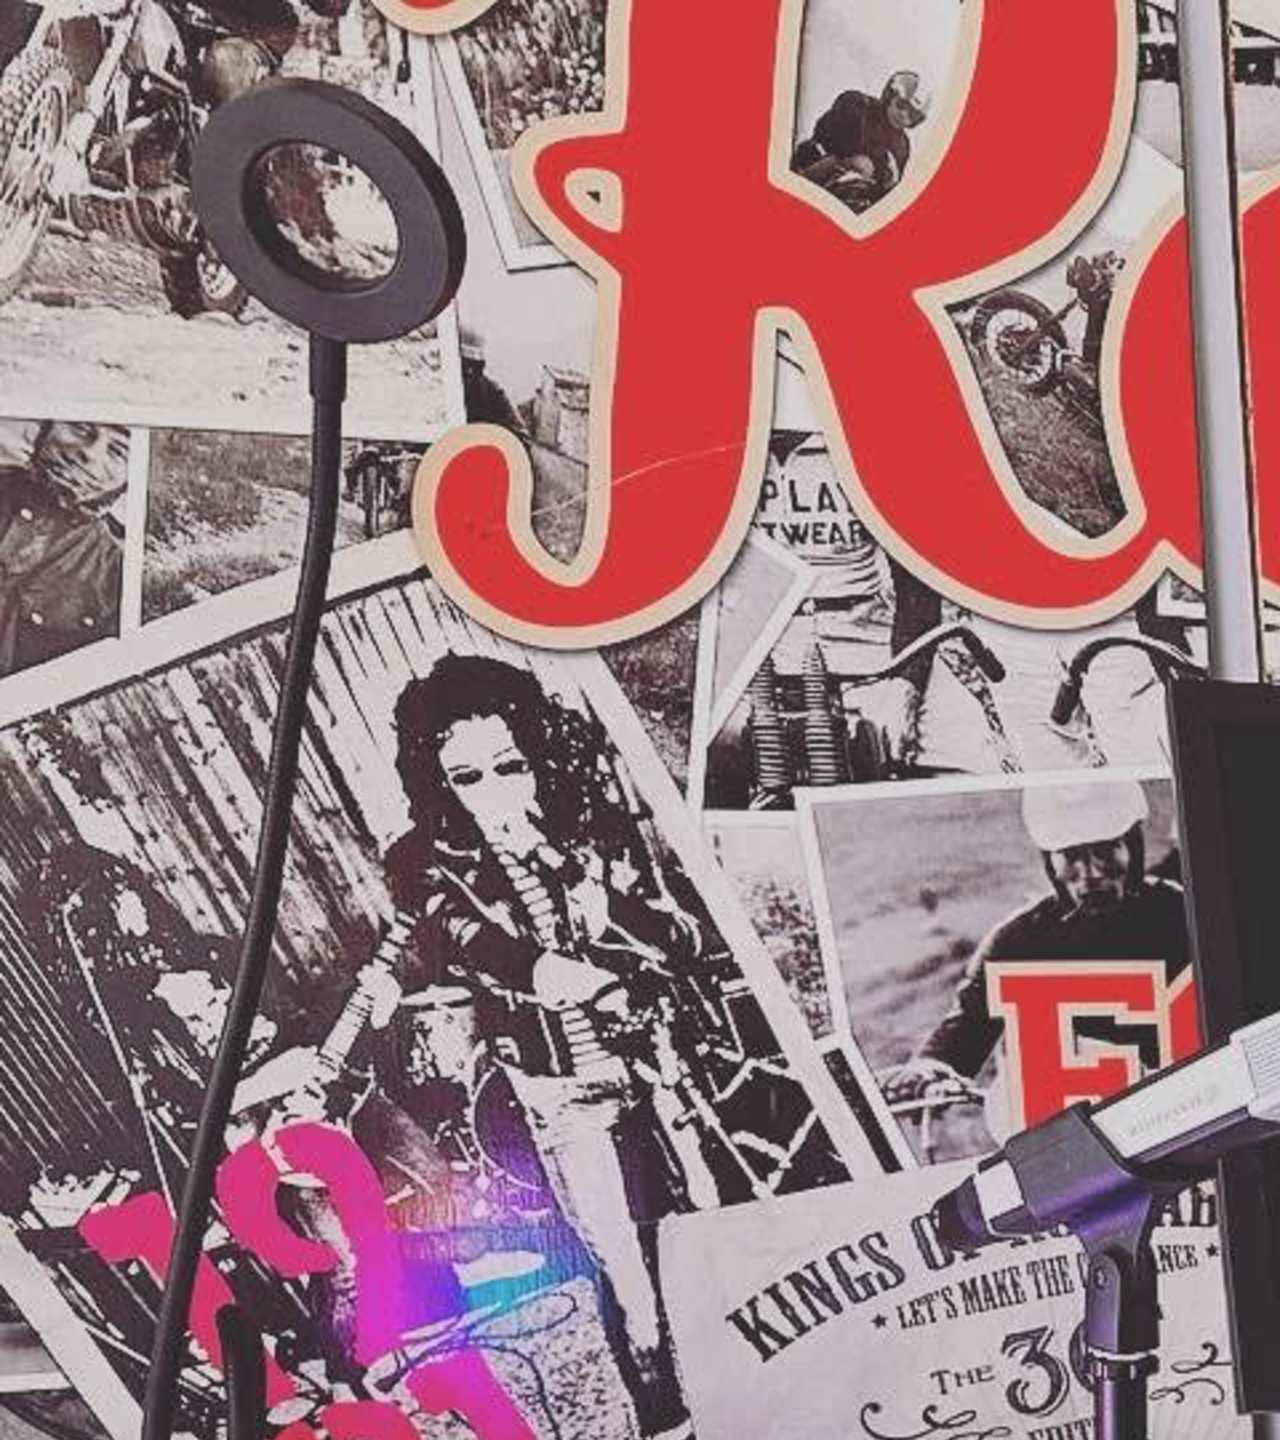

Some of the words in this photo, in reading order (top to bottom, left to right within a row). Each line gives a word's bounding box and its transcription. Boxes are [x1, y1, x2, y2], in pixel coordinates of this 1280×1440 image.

[726, 1231, 906, 1363] KINGS
[897, 1286, 958, 1329] LET'S
[957, 1266, 1027, 1317] MAKE
[1025, 1254, 1075, 1300] THE
